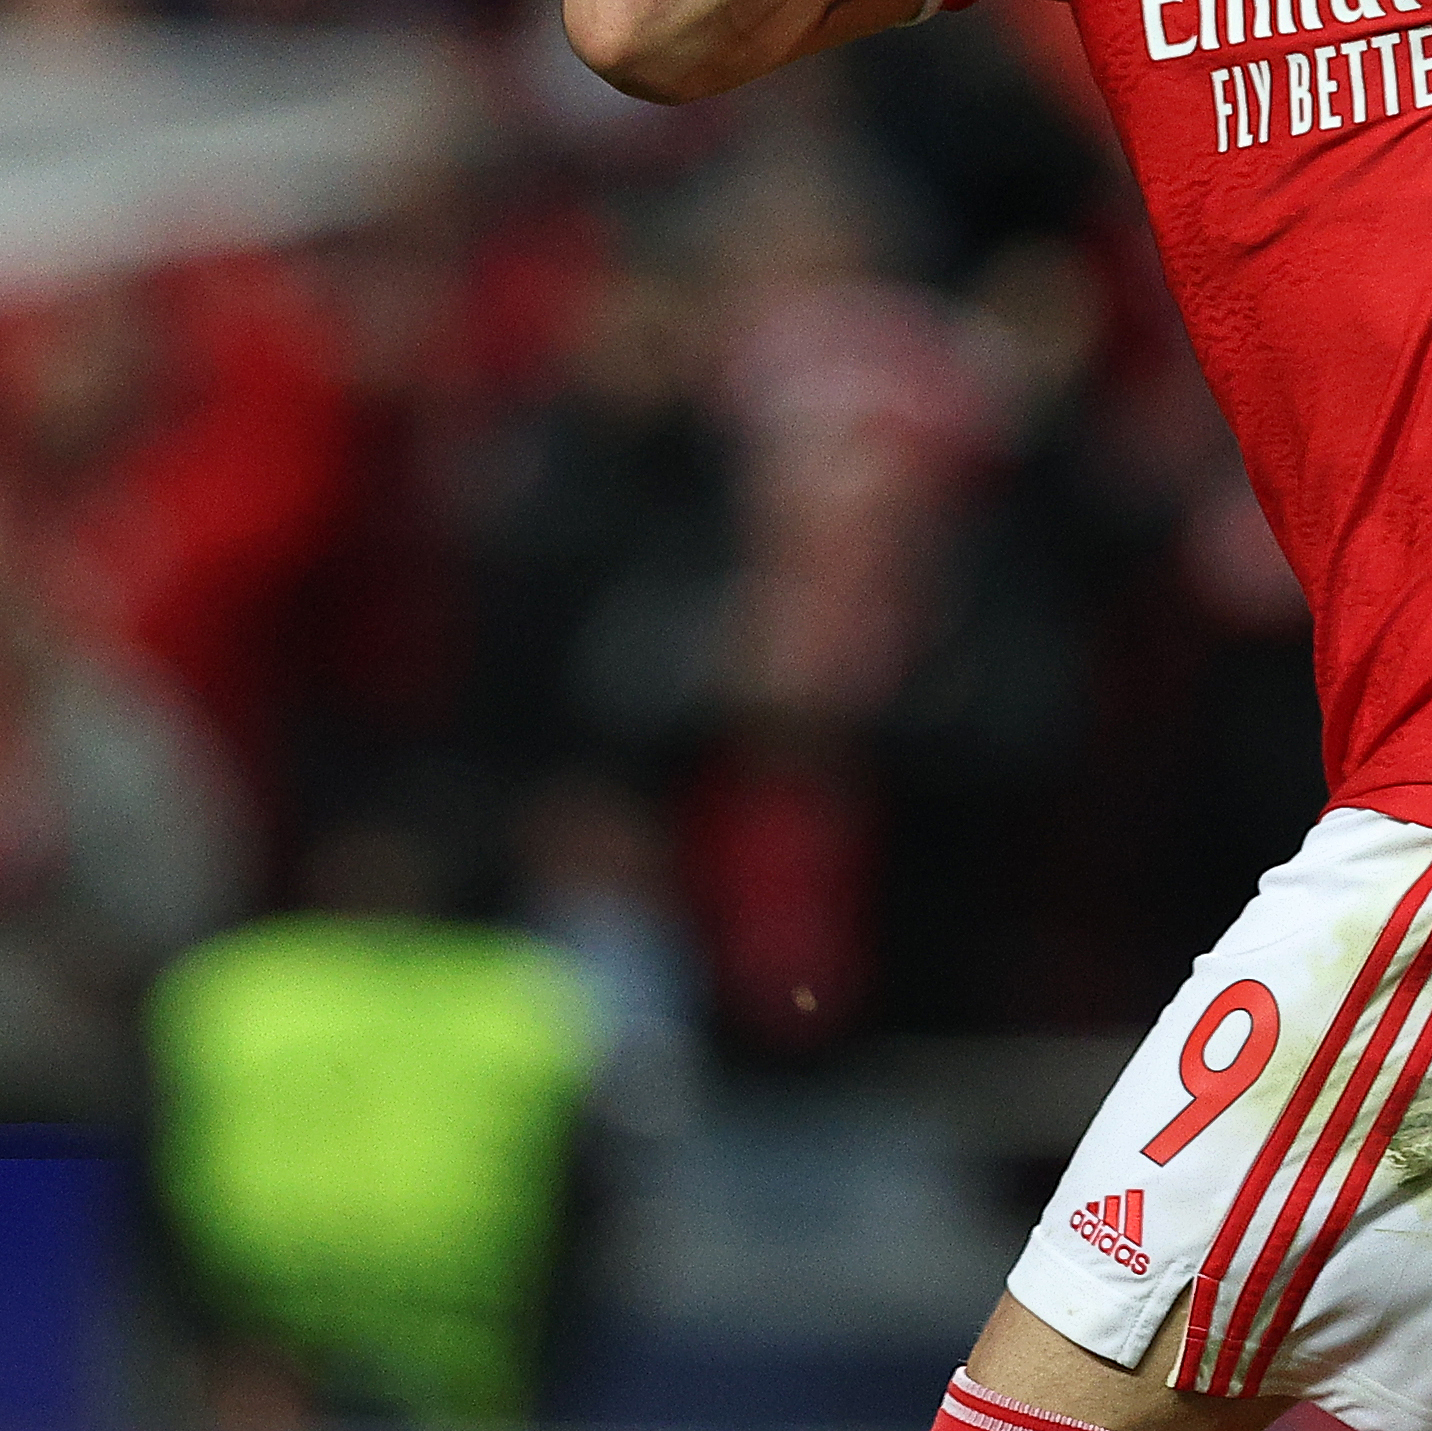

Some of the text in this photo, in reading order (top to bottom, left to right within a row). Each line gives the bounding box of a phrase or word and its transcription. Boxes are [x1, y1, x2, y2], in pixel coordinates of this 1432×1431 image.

[1211, 59, 1273, 153] FLY
[1140, 978, 1280, 1168] 9
[1069, 1209, 1151, 1276] adidas
